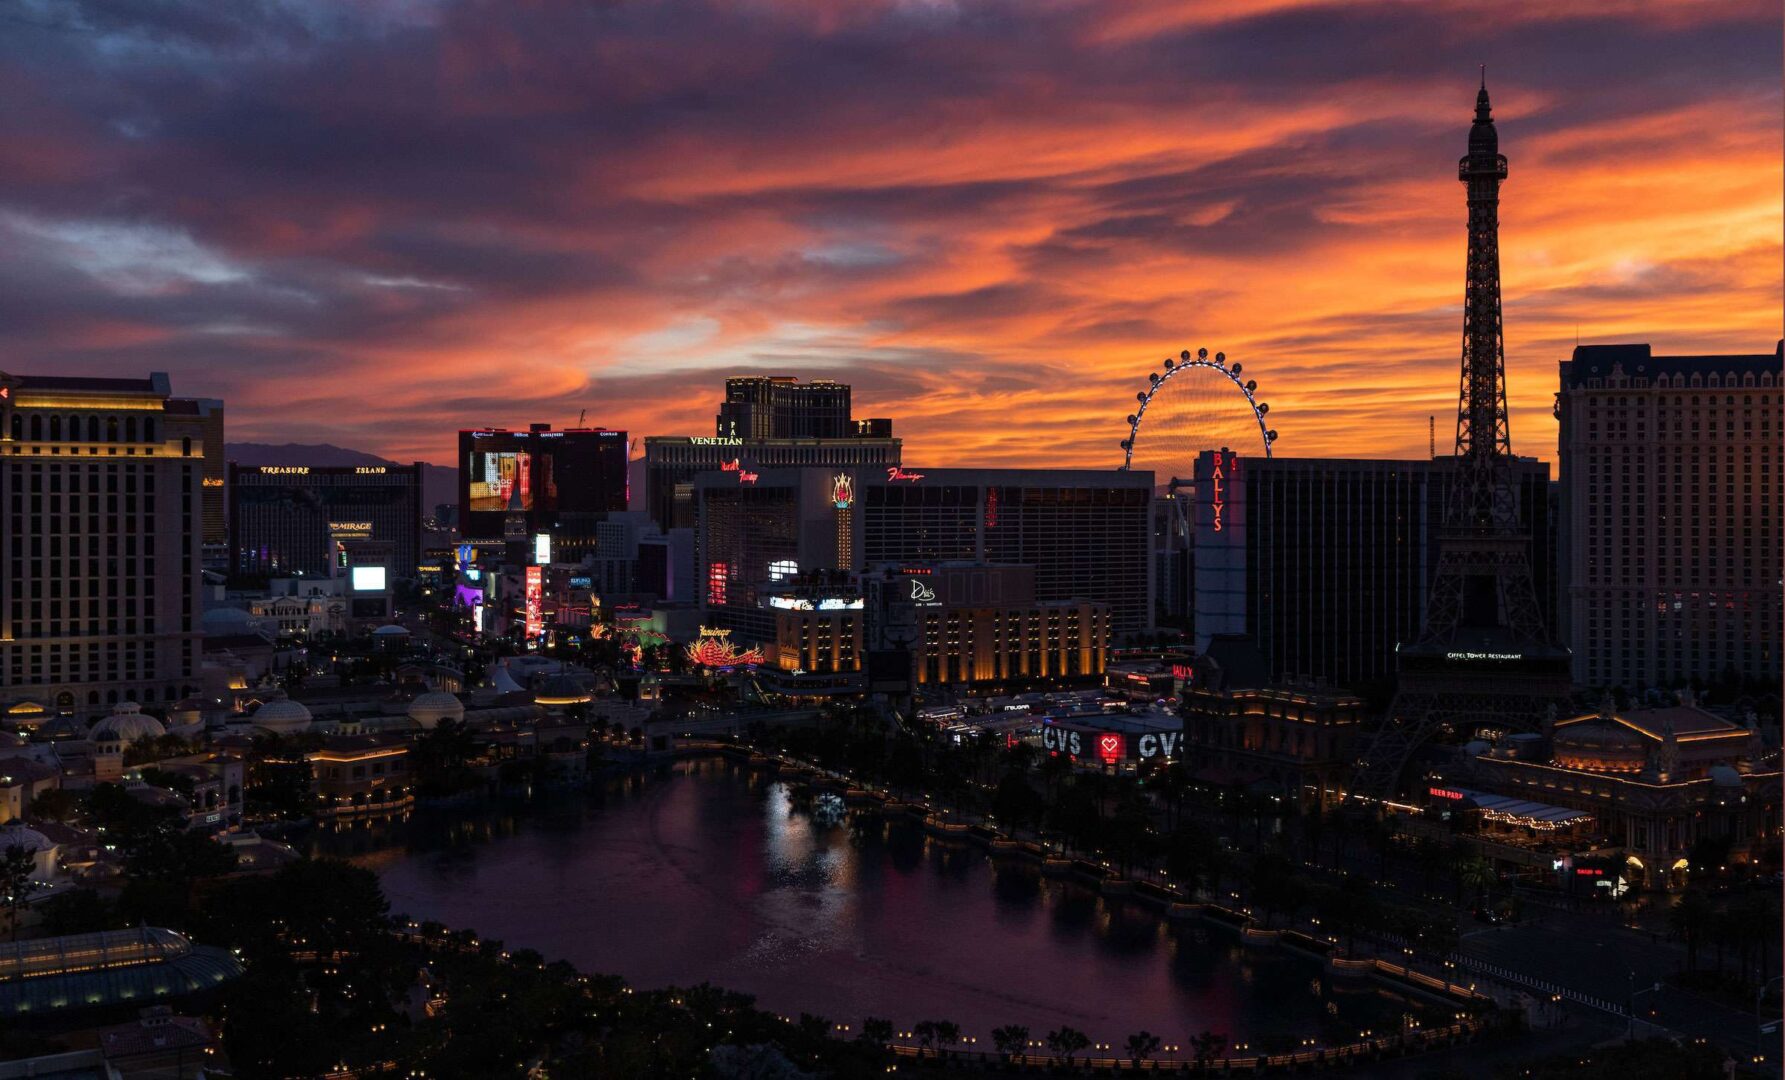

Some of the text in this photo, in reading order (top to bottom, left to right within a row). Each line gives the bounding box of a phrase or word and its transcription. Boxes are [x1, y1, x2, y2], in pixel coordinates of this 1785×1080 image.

[690, 437, 743, 445] VENETIAN
[260, 466, 310, 475] TREASURE
[887, 465, 925, 483] Flamingo
[1212, 453, 1224, 532] BALLYS
[1043, 726, 1081, 755] CVS
[1139, 732, 1184, 758] CV
[1430, 788, 1464, 799] BEER PARK
